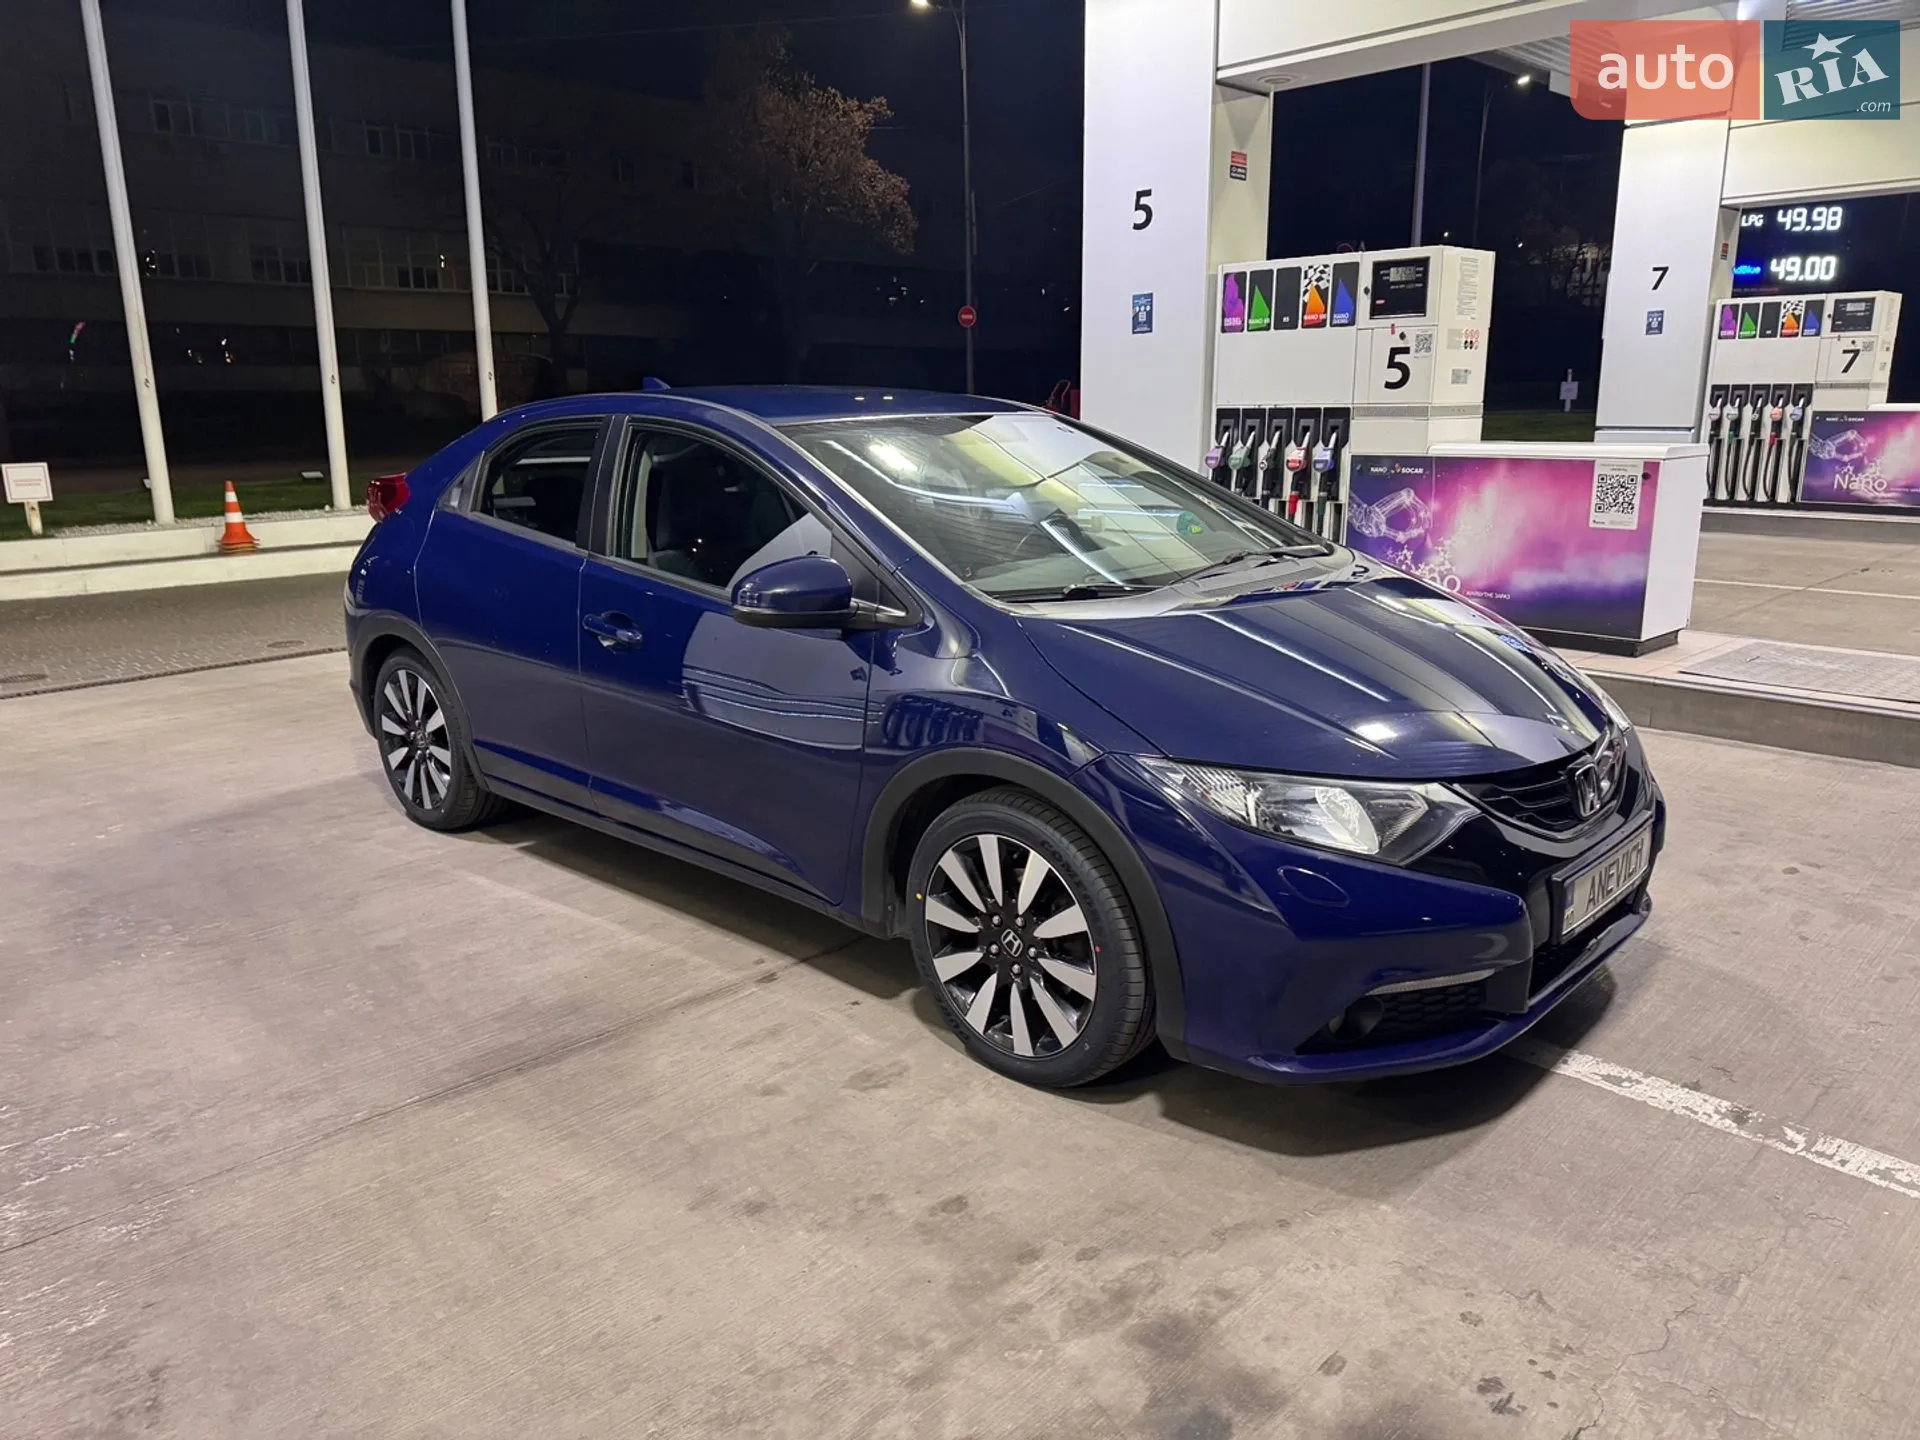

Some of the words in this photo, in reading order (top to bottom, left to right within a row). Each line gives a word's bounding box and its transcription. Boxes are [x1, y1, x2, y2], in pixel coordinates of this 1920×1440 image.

[1132, 188, 1154, 231] 5
[1741, 213, 1764, 227] LPG
[1776, 206, 1843, 232] 49.98
[1651, 266, 1669, 291] 7
[1769, 256, 1837, 281] 49.00
[1384, 346, 1411, 390] 5
[1841, 349, 1861, 374] 7
